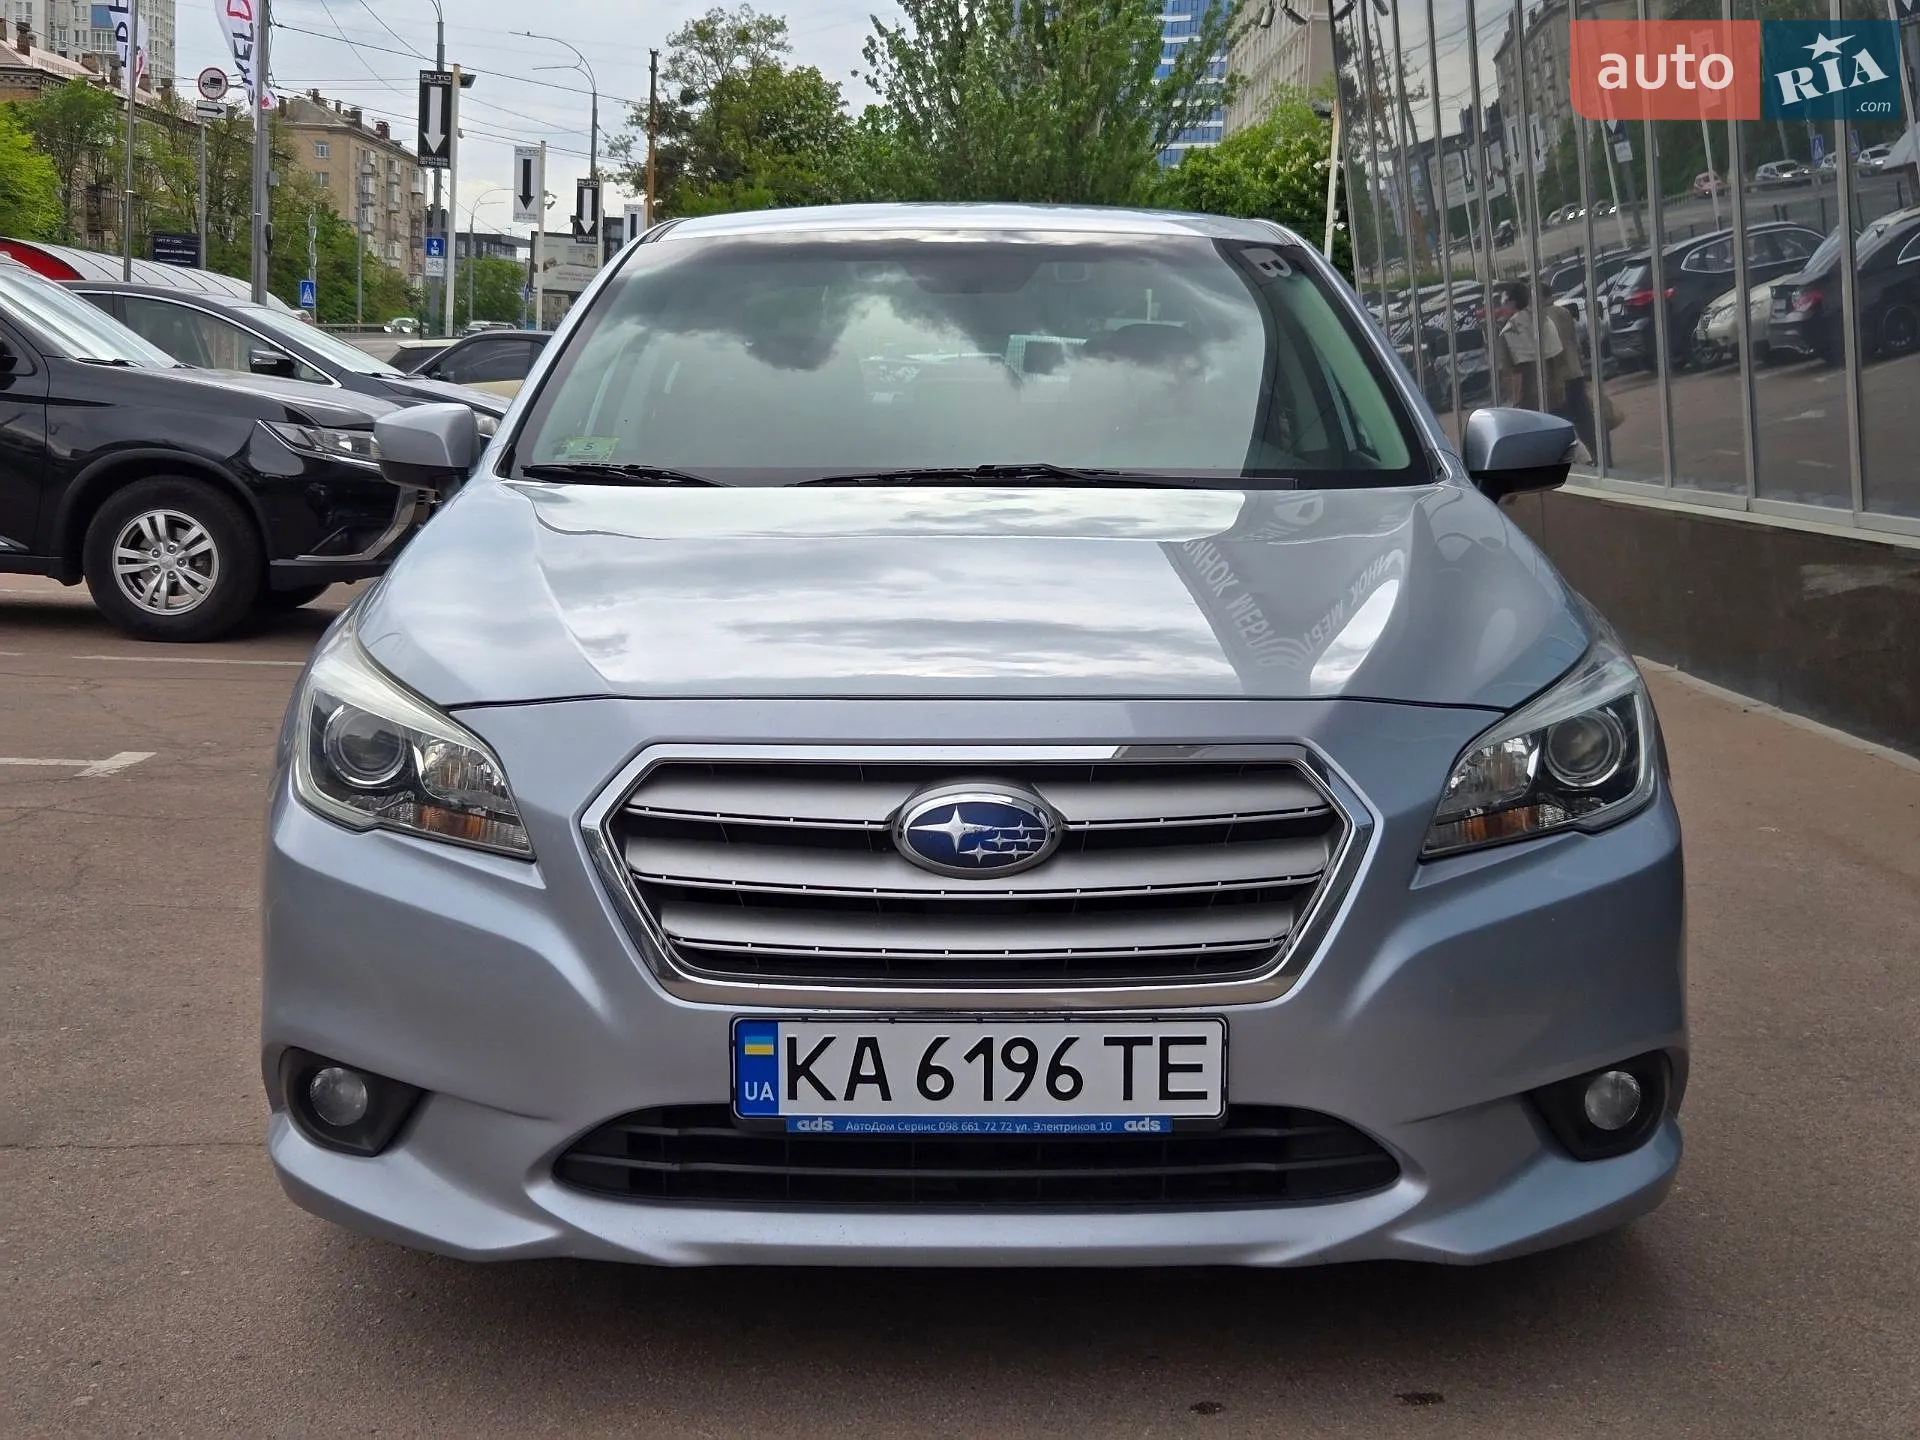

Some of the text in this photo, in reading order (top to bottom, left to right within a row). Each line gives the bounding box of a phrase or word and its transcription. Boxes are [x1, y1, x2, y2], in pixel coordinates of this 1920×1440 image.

[421, 73, 452, 81] AUTO
[786, 1036, 1208, 1101] KA 6196 TE
[744, 1081, 775, 1101] UA
[796, 1116, 1161, 1134] ads АвтоДом Сервис 098 661 72 72 ул. Электриков 10 ads
